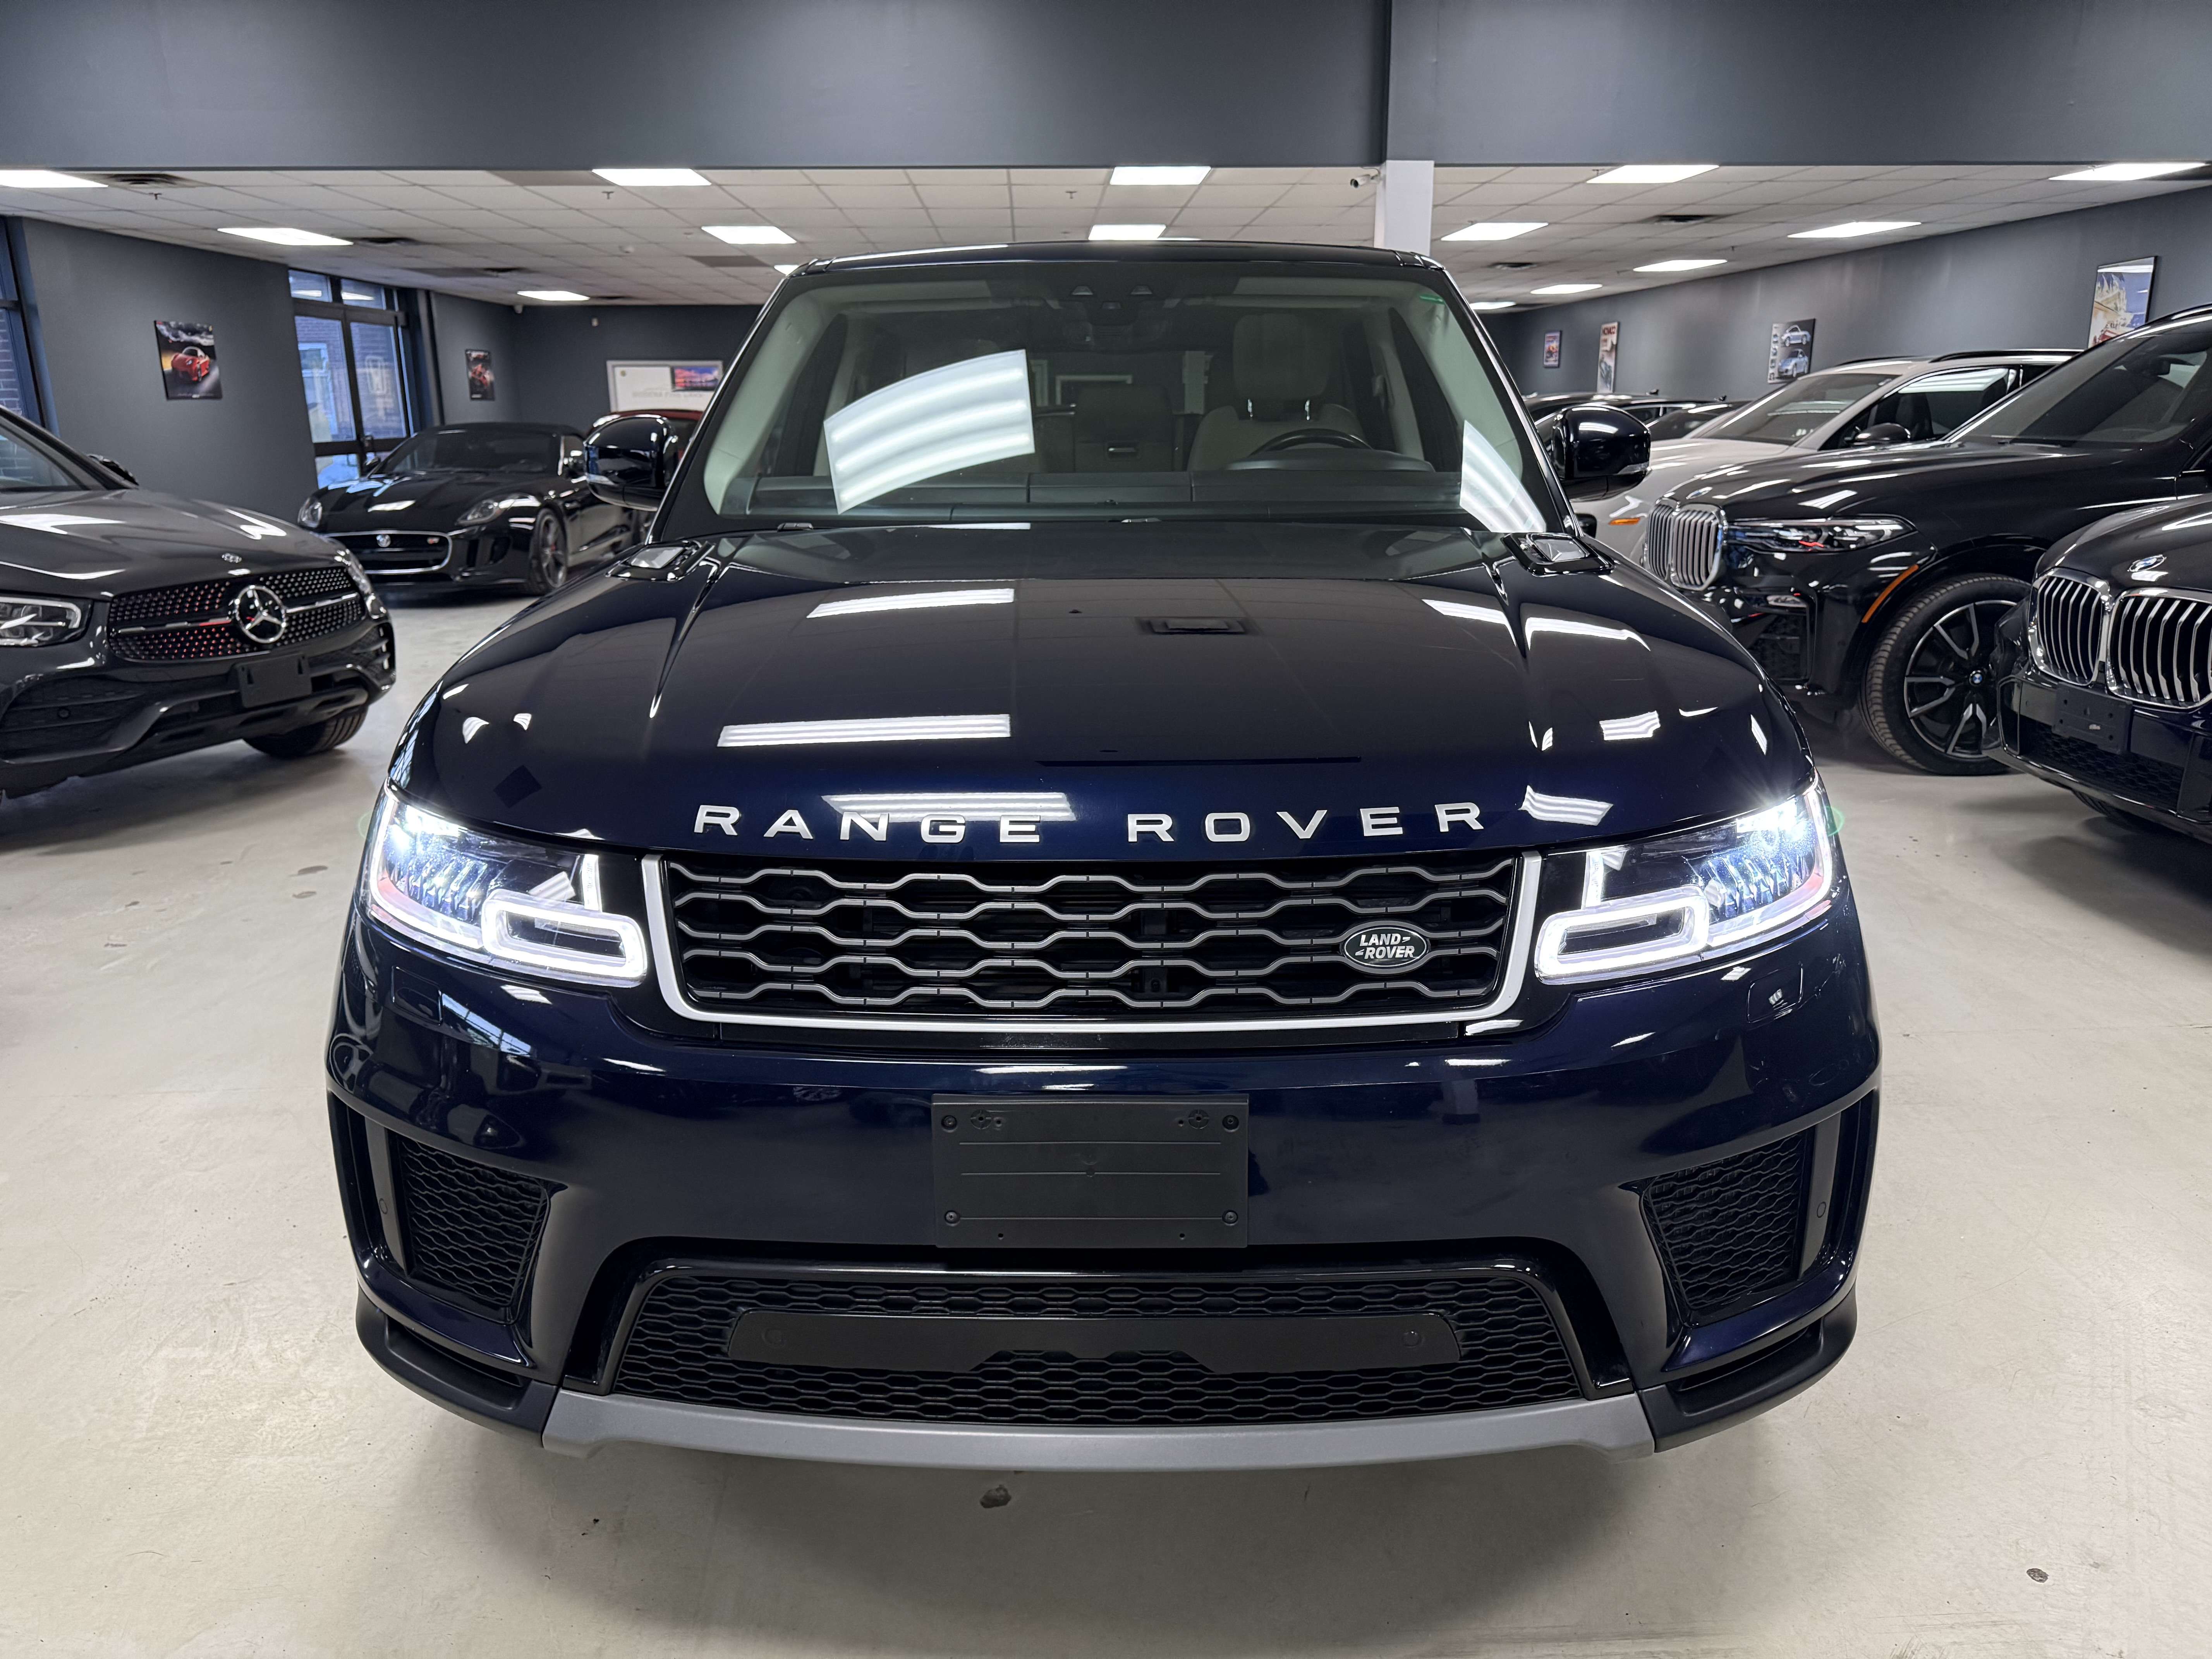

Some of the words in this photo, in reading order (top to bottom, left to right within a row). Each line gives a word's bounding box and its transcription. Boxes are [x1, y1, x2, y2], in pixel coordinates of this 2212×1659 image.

[694, 804, 1040, 843] RANGE
[1127, 802, 1484, 842] ROVER
[1360, 933, 1401, 946] LAND
[1364, 945, 1415, 960] ROVER
